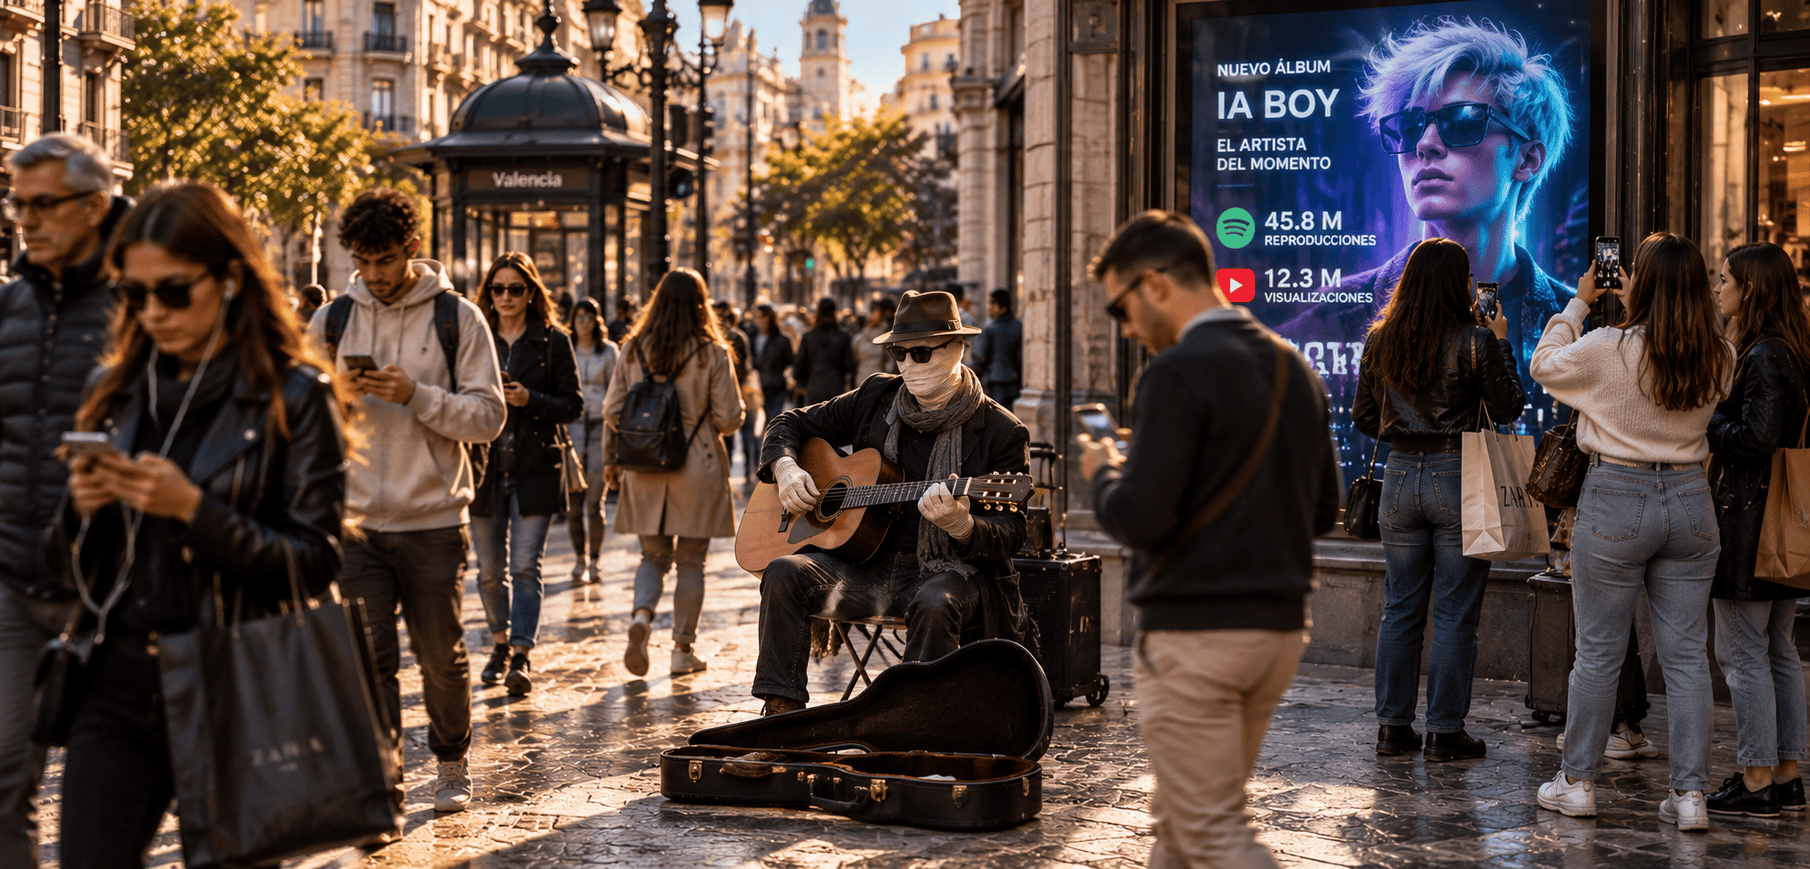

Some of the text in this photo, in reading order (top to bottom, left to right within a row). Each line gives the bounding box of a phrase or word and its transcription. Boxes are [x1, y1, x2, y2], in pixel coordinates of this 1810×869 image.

[1217, 58, 1331, 77] NUEVO ÁLBUM
[1218, 89, 1340, 119] IA BOY
[1217, 138, 1307, 152] EL ARTISTA
[1217, 157, 1331, 171] DEL MOMENTO
[492, 170, 563, 188] Valencia
[1265, 211, 1342, 230] 45.8 M
[1265, 235, 1376, 246] REPRODUCCIONES
[1265, 268, 1341, 288] 12.3 M
[1265, 292, 1373, 303] VISUALIZACIONES
